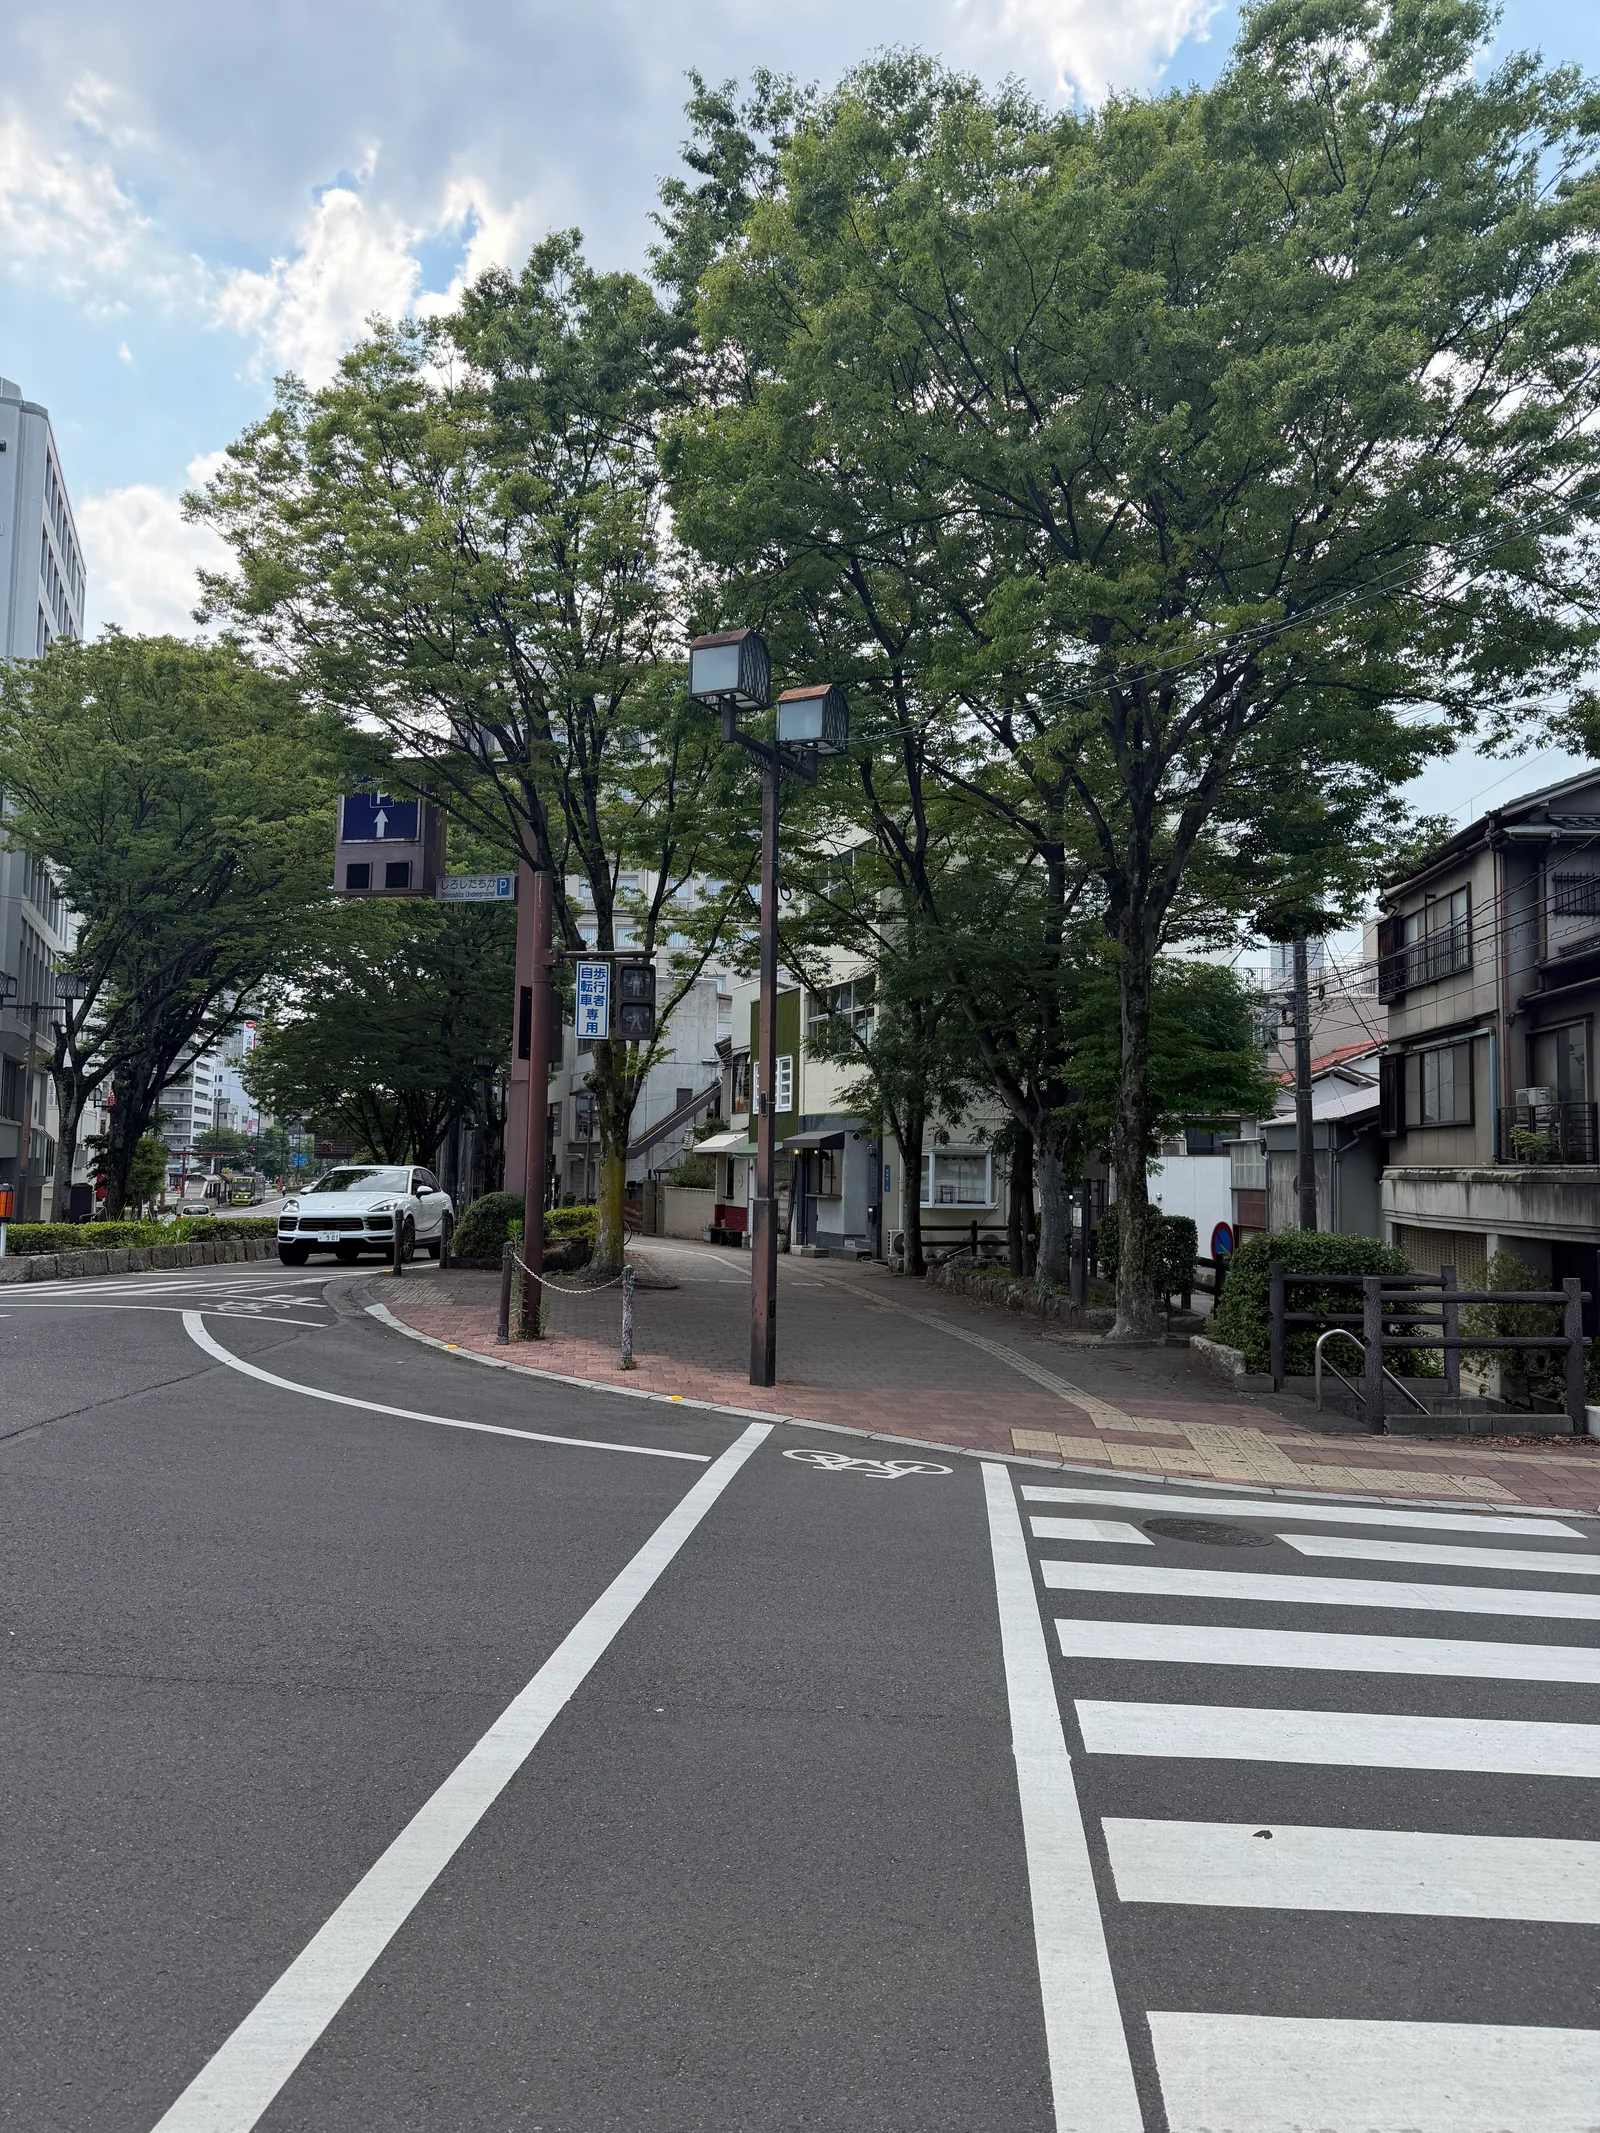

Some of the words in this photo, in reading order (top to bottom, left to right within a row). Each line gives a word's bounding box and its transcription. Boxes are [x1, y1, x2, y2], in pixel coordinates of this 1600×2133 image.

[441, 891, 464, 899] Shiroshita
[465, 890, 495, 898] Underground
[580, 967, 593, 1006] 自転車
[593, 968, 606, 1006] 歩行者
[586, 1008, 599, 1033] 専用
